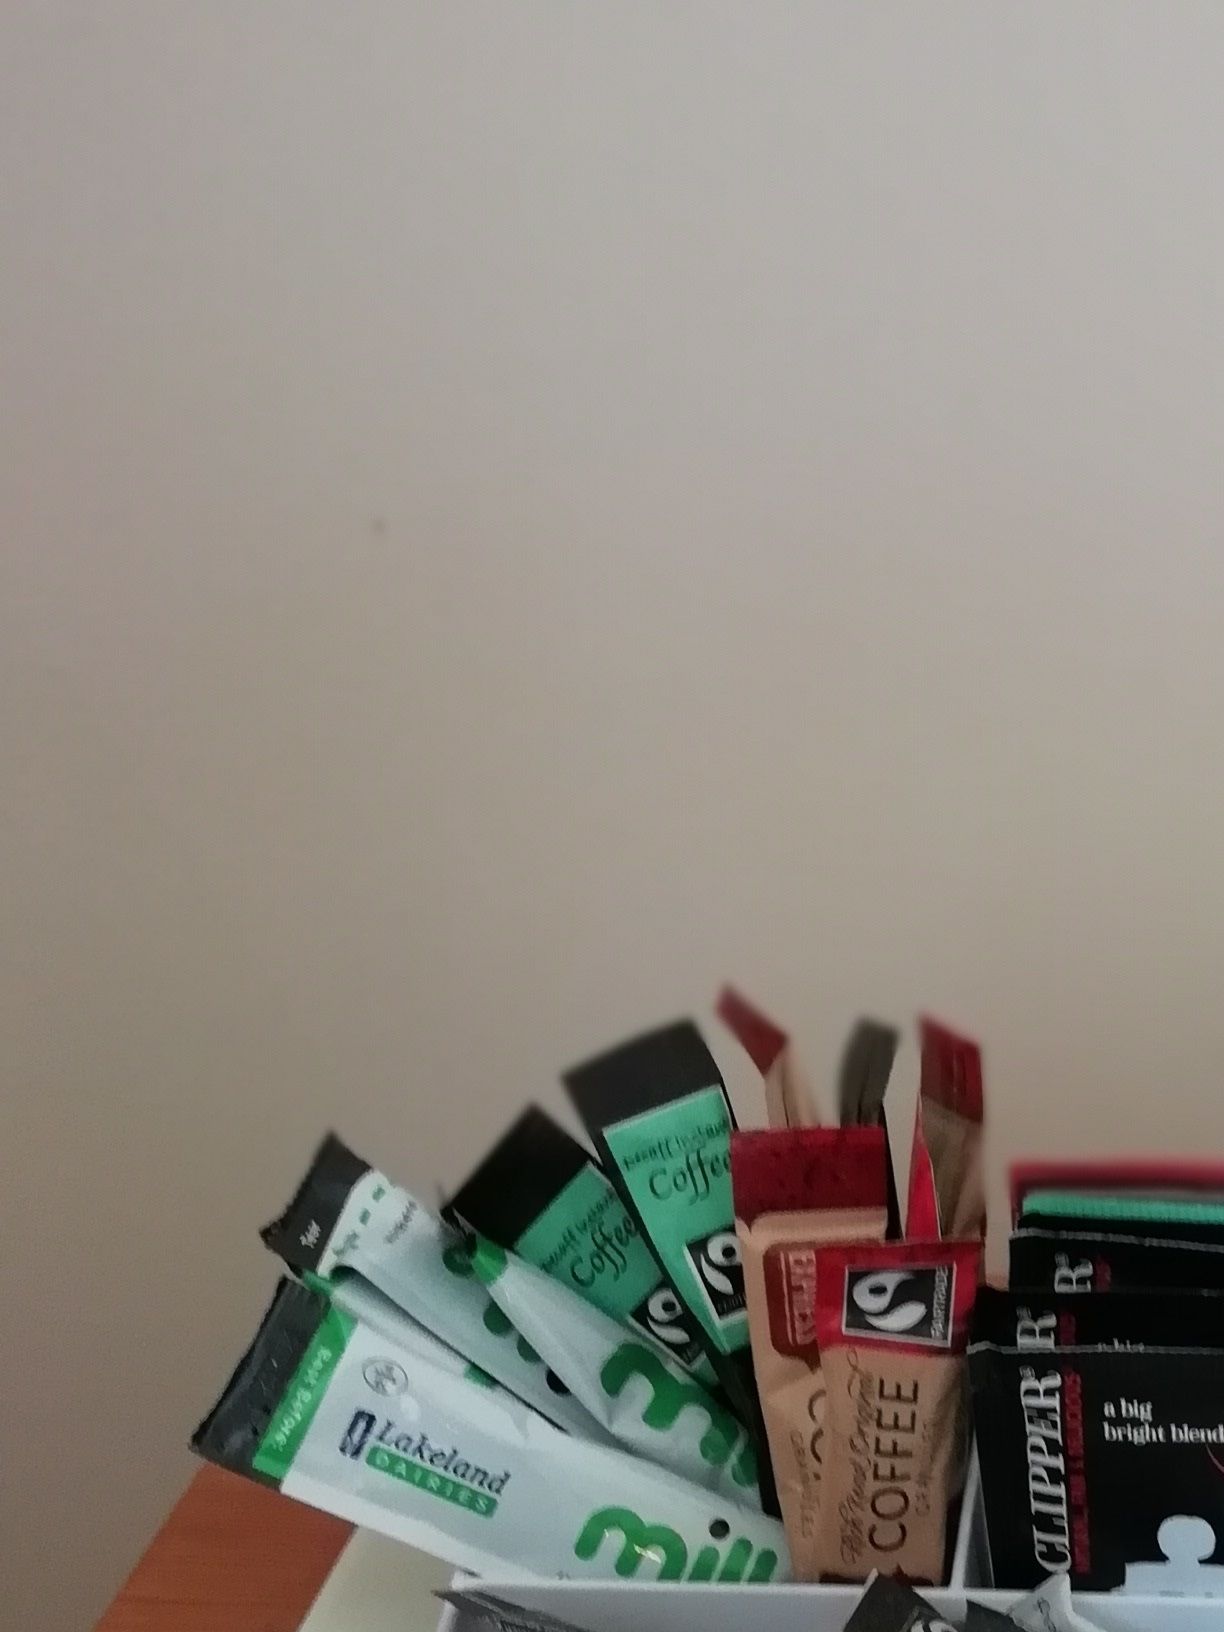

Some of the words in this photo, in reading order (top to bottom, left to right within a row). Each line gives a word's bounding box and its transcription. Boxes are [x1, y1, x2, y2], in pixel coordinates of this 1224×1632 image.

[570, 1215, 640, 1288] Coffee
[1103, 1400, 1116, 1419] a
[1119, 1397, 1153, 1423] big
[1103, 1421, 1166, 1446] bright
[374, 1450, 490, 1512] DAIRIES
[376, 1418, 512, 1497] Lakeland
[867, 1375, 919, 1553] COFFEE
